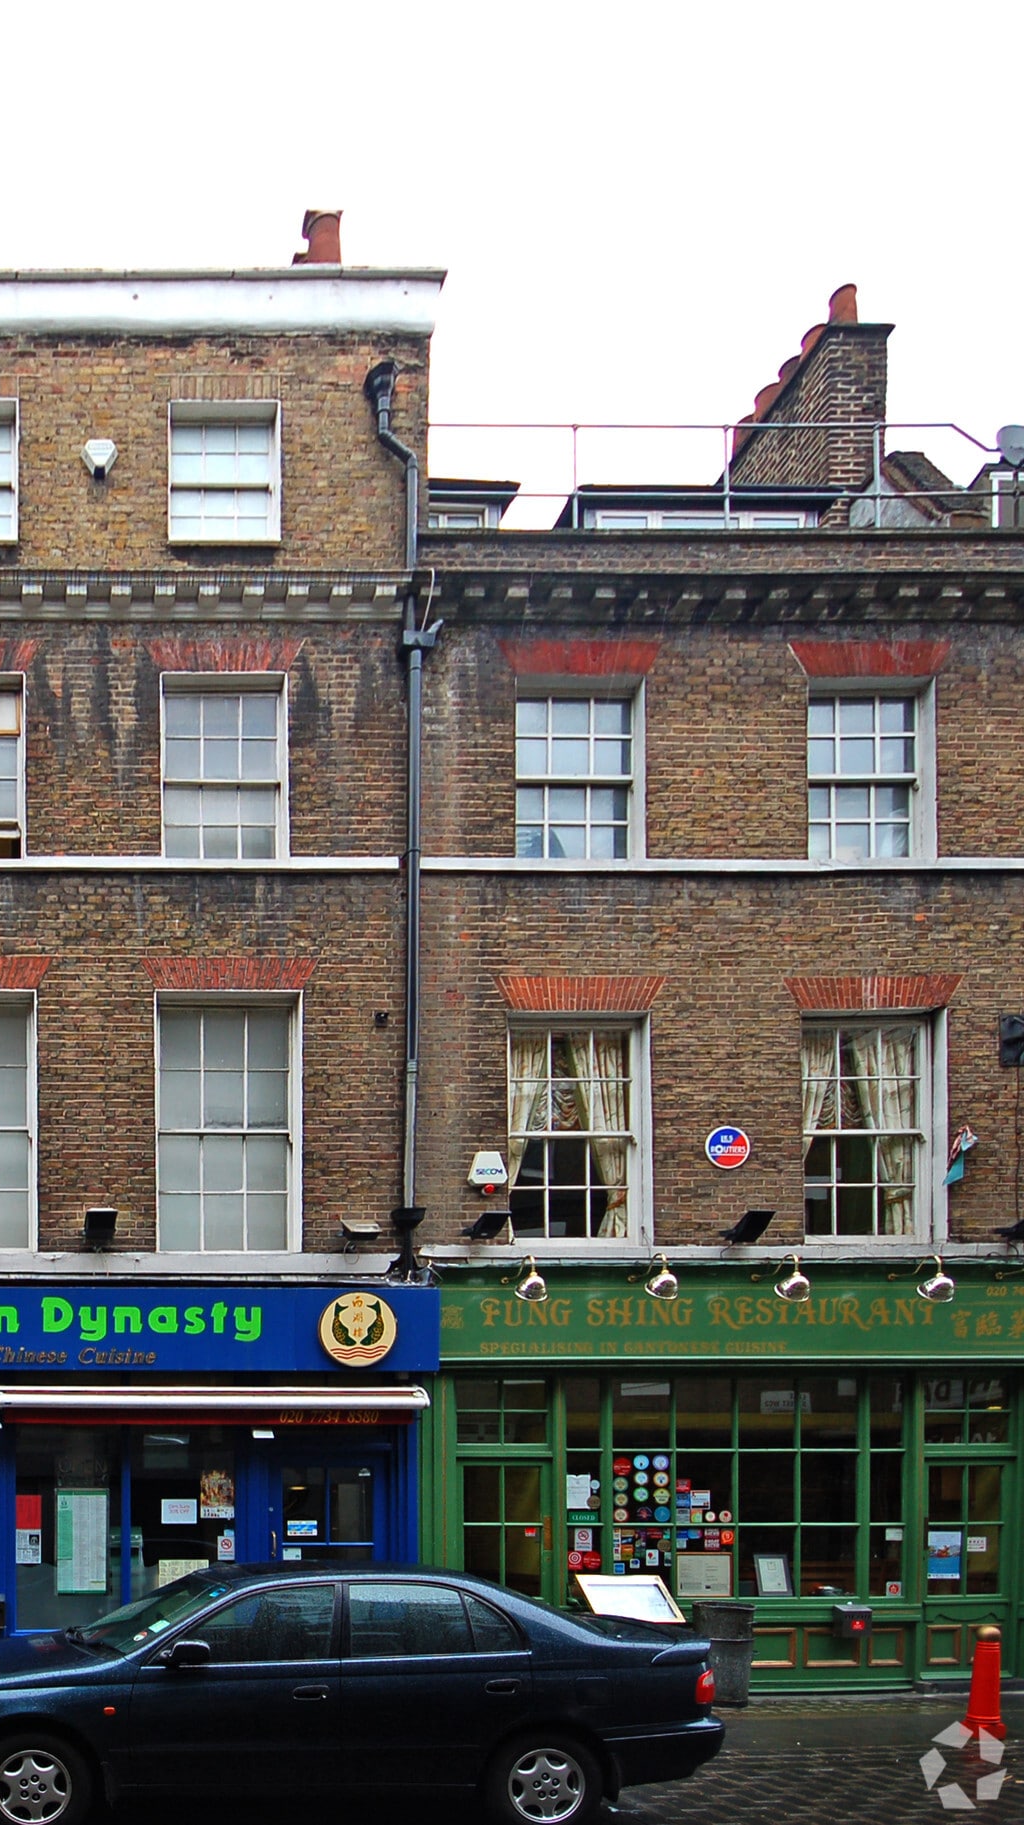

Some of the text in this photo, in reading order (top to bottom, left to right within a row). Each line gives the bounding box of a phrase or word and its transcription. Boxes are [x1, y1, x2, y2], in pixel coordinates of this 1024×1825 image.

[720, 1135, 734, 1144] LES
[710, 1145, 747, 1154] ROUTIERS
[476, 1168, 503, 1176] SECOM
[41, 1296, 262, 1342] Dynasty
[480, 1297, 937, 1330] FUNG SHING RESTAURANT
[479, 1341, 788, 1355] SPECIALISING IN CANTONESE CUISINE
[78, 1347, 157, 1366] Cuisine
[279, 1410, 304, 1424] 020
[311, 1410, 340, 1424] 7734
